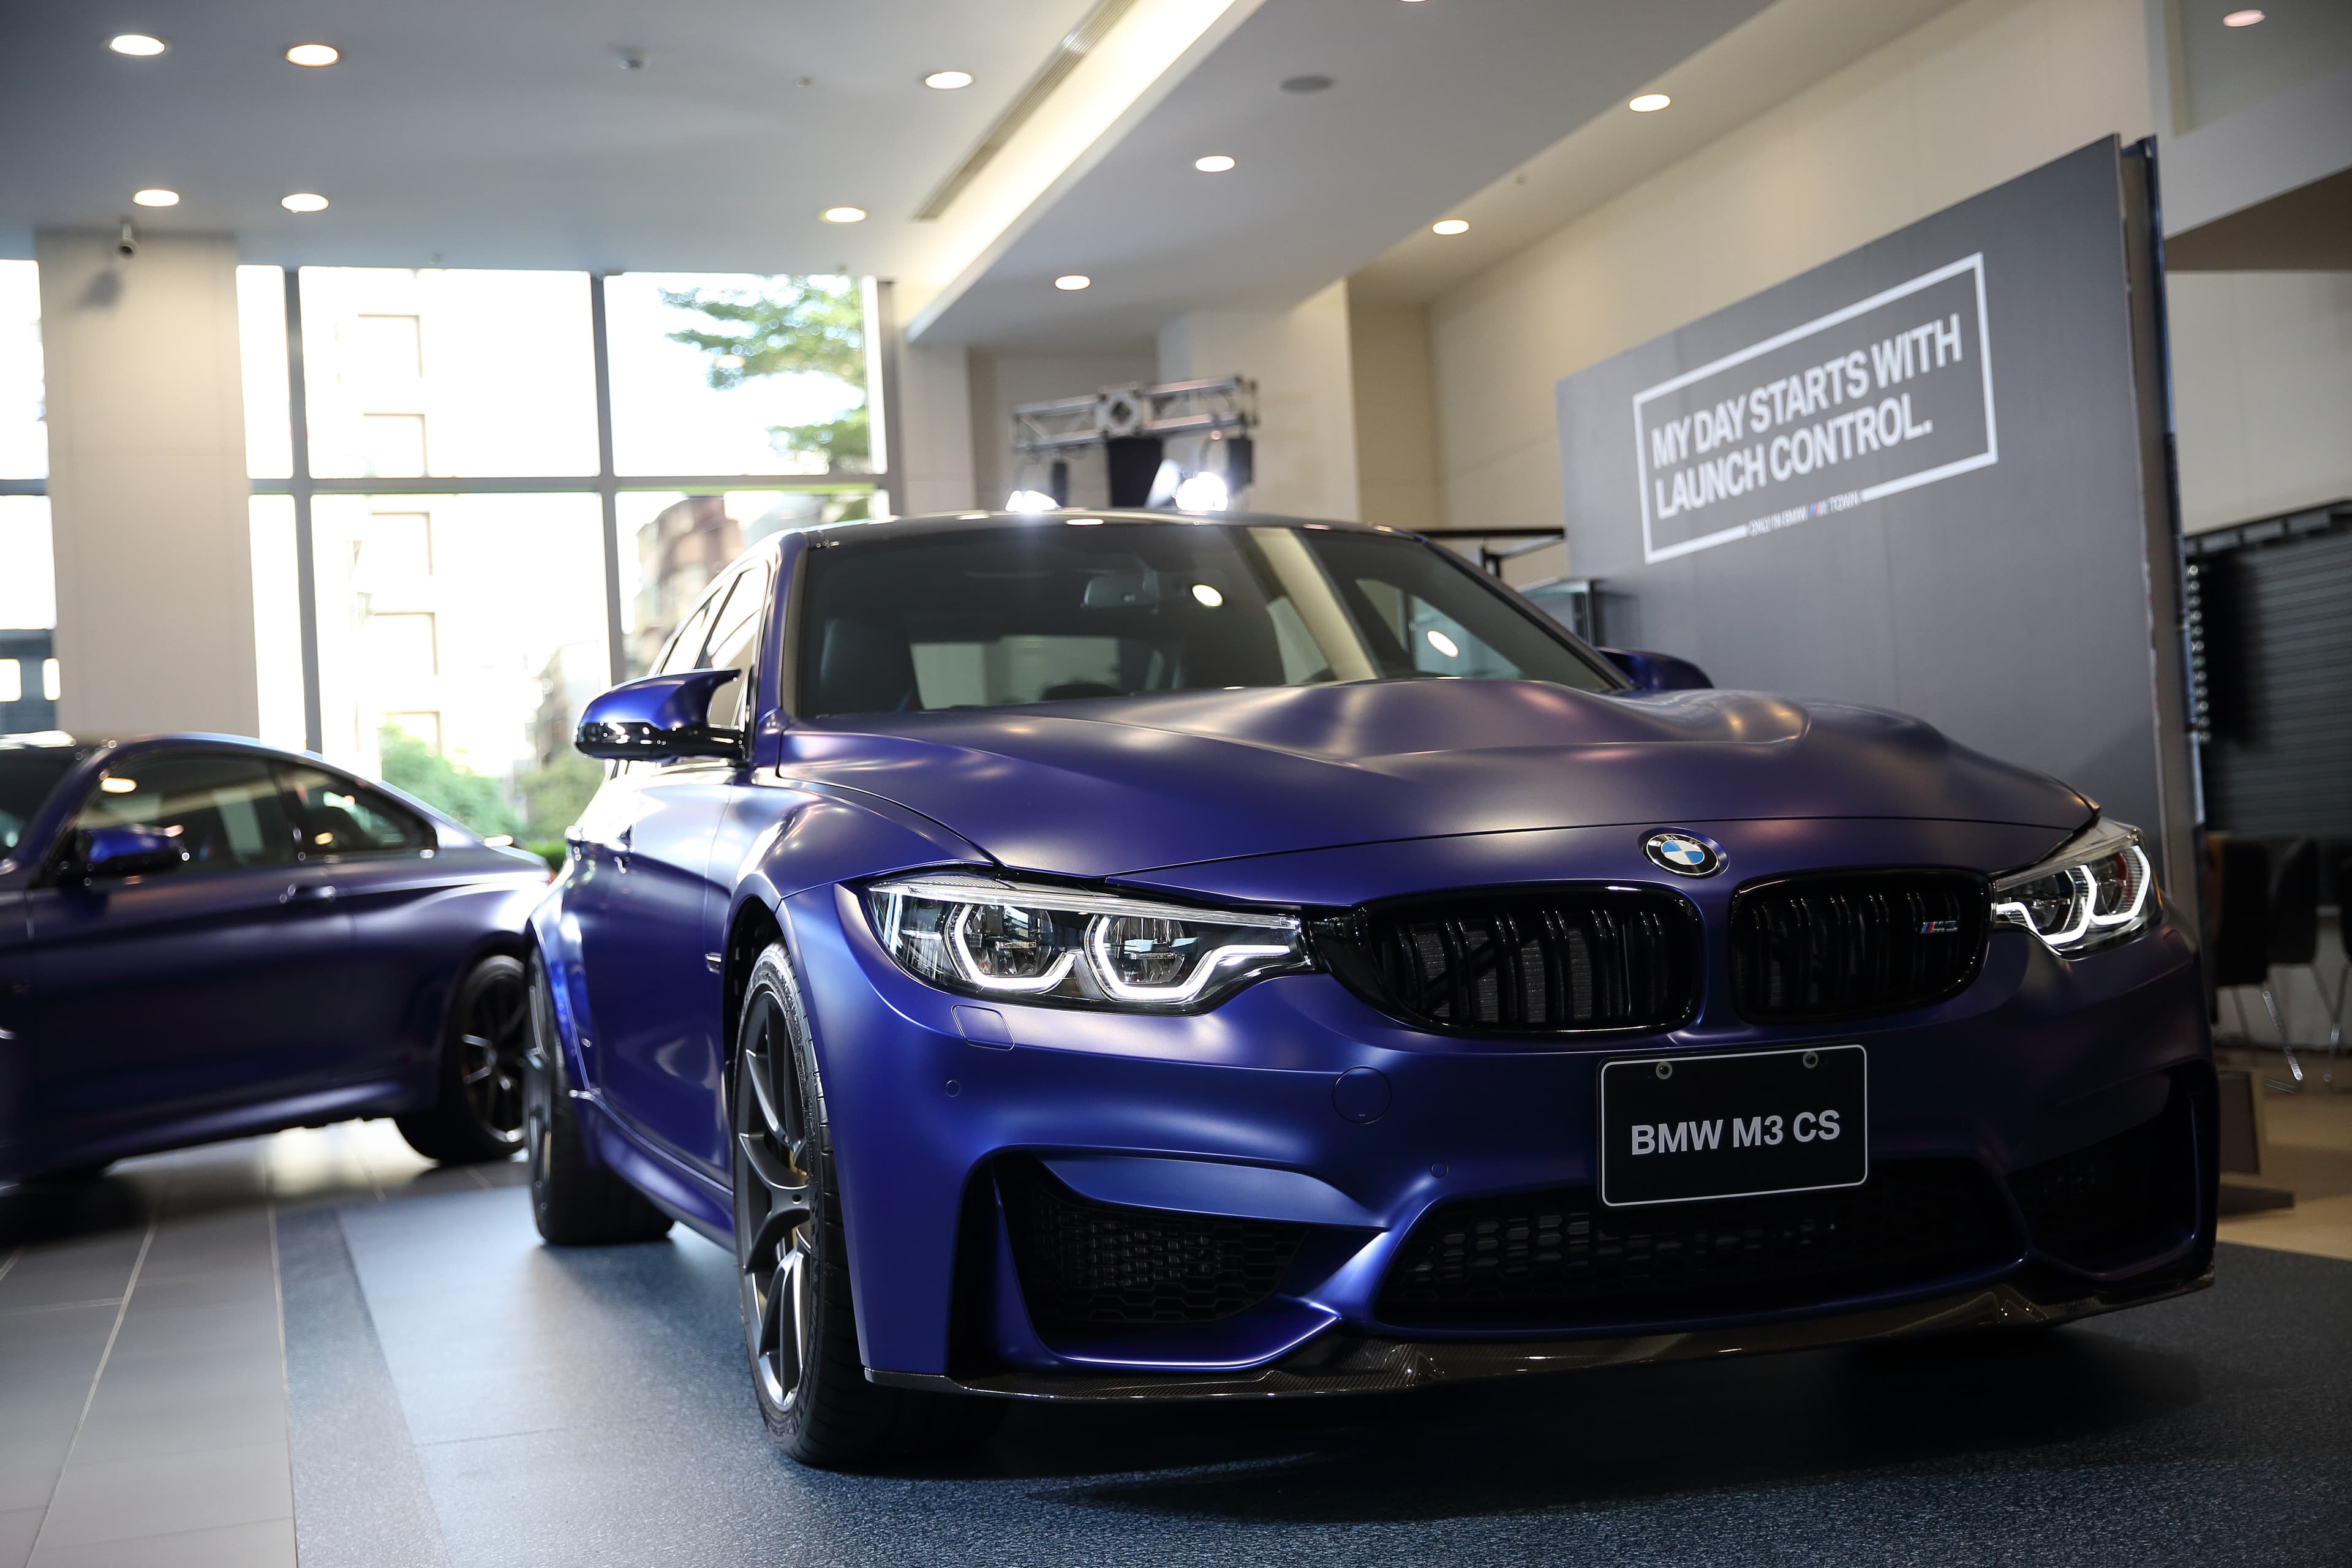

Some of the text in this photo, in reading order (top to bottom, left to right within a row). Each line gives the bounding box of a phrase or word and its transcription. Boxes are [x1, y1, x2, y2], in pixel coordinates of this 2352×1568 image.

[1651, 313, 1962, 470] MY DAY STARTS WITH
[1654, 393, 1933, 520] LAUNCH CONTROL.
[1631, 1109, 1841, 1155] BMW M3 CS
